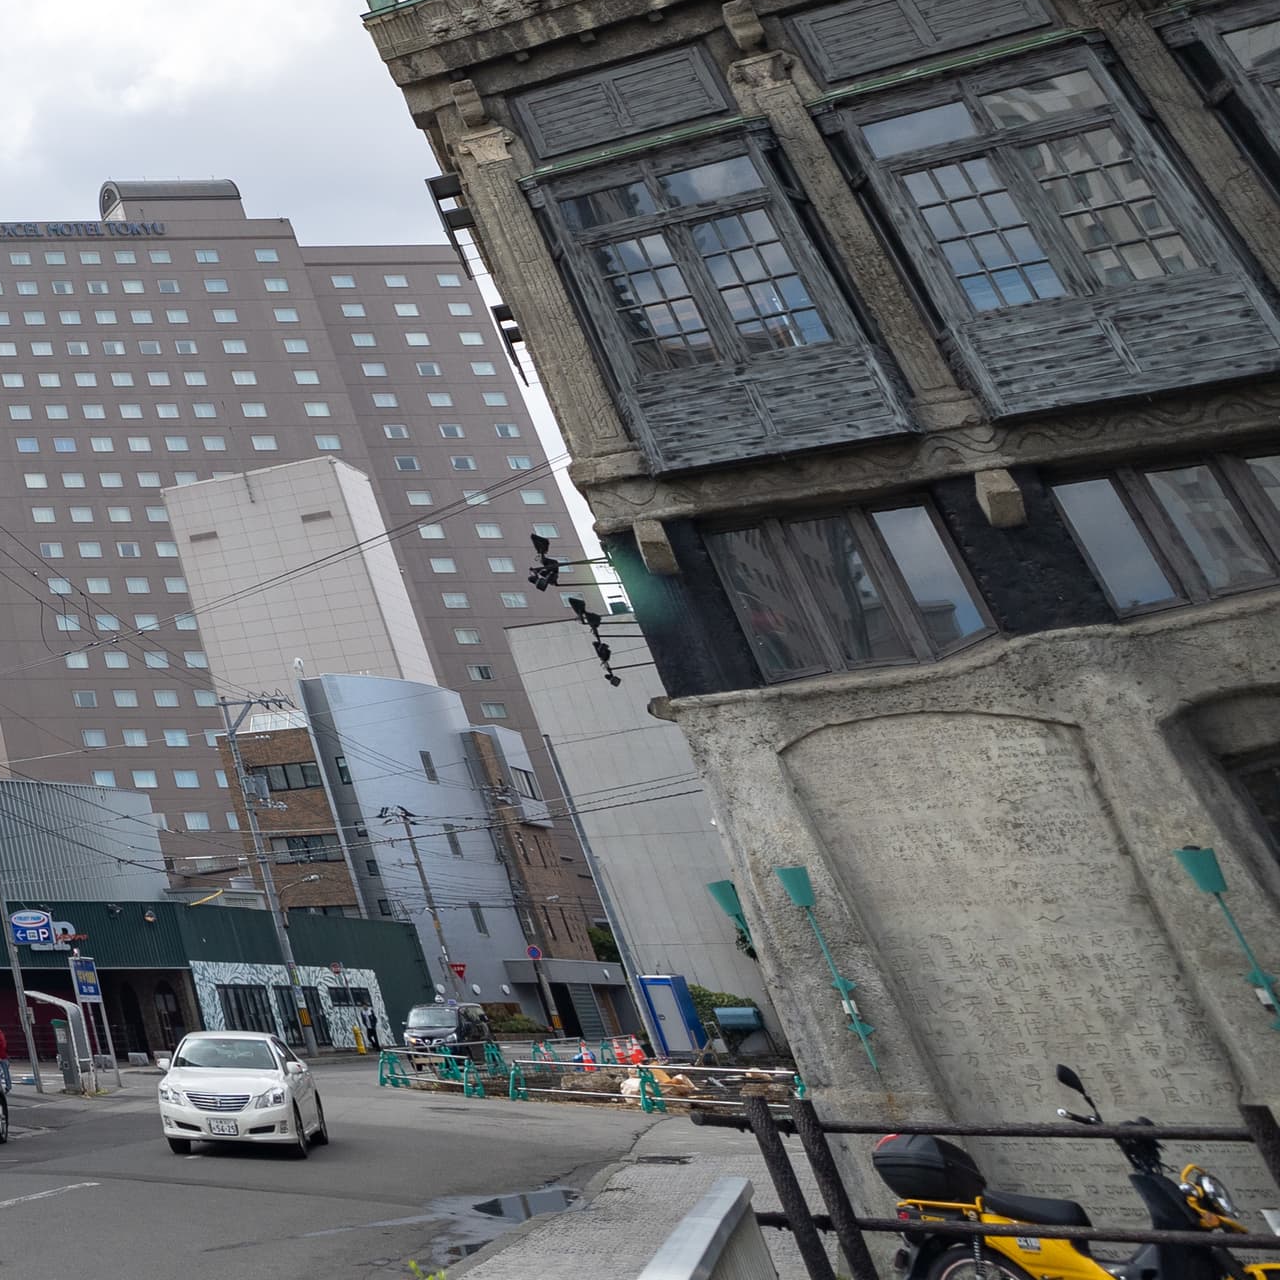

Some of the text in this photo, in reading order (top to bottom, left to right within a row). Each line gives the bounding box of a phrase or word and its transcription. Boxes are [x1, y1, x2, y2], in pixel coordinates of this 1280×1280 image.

[46, 223, 104, 237] HOTEL
[105, 222, 169, 236] TOKYU
[40, 929, 50, 943] P
